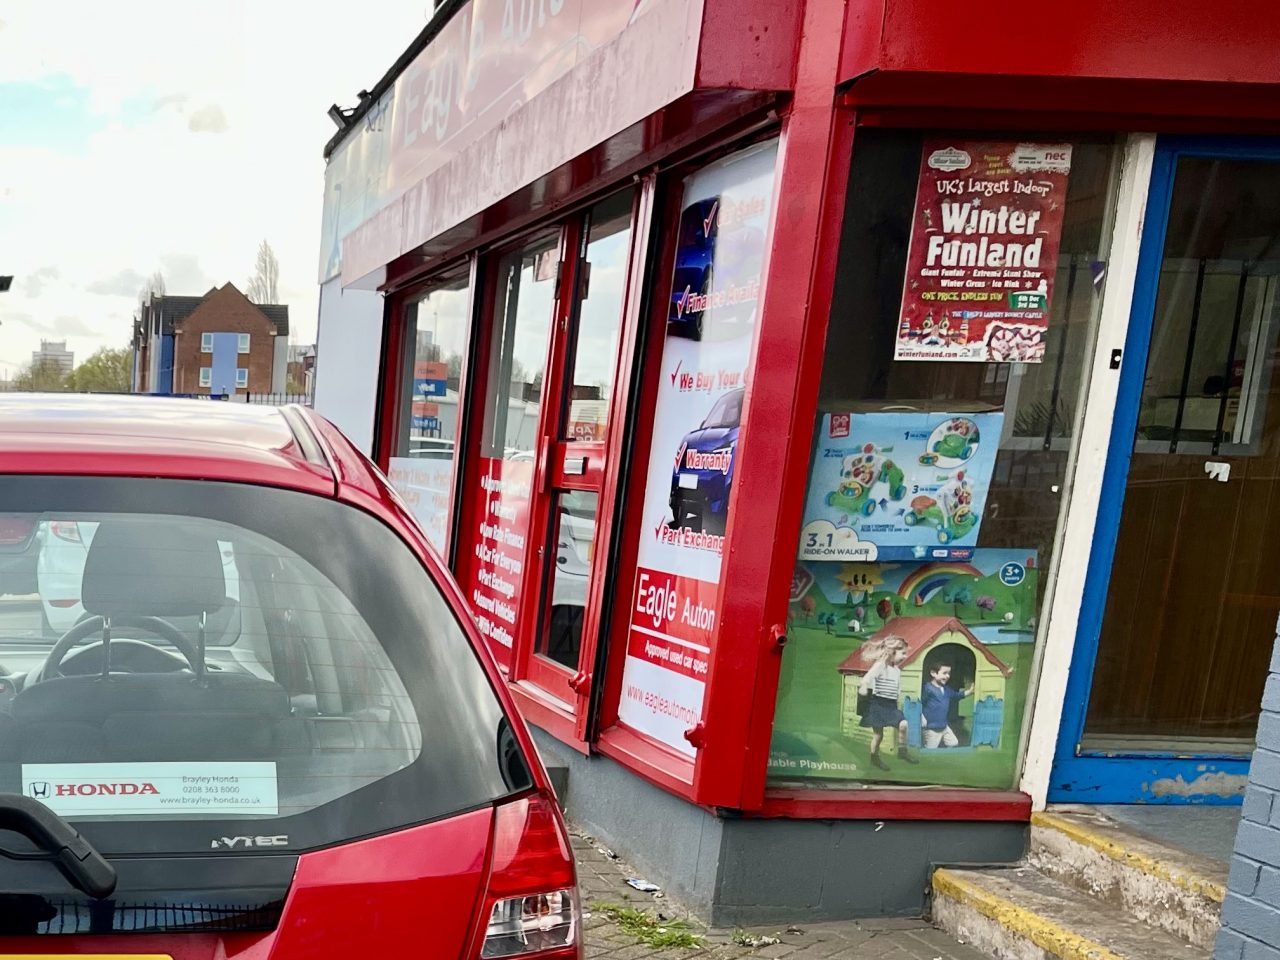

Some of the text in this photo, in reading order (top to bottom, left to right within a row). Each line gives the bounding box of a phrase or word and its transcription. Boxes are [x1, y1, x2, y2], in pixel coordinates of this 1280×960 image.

[1044, 151, 1066, 161] nec
[936, 178, 1050, 197] UK's Largest Indoor
[941, 202, 1041, 235] Winter
[926, 235, 1043, 268] Funland
[921, 268, 1042, 278] Giant Funfair Extreme Stunt Show
[940, 279, 1020, 288] Winter Circus Ice Rink
[685, 449, 732, 475] Warranty
[662, 524, 683, 546] Part
[806, 532, 818, 547] 3
[826, 532, 833, 547] 1
[837, 548, 870, 556] WALKER
[1005, 566, 1020, 576] 3+
[636, 573, 677, 628] Eagle
[645, 640, 670, 661] Approved
[669, 650, 684, 666] used
[683, 655, 694, 669] car
[799, 759, 857, 771] Playhouse
[182, 776, 239, 785] Brayley Honda
[55, 782, 160, 797] HONDA
